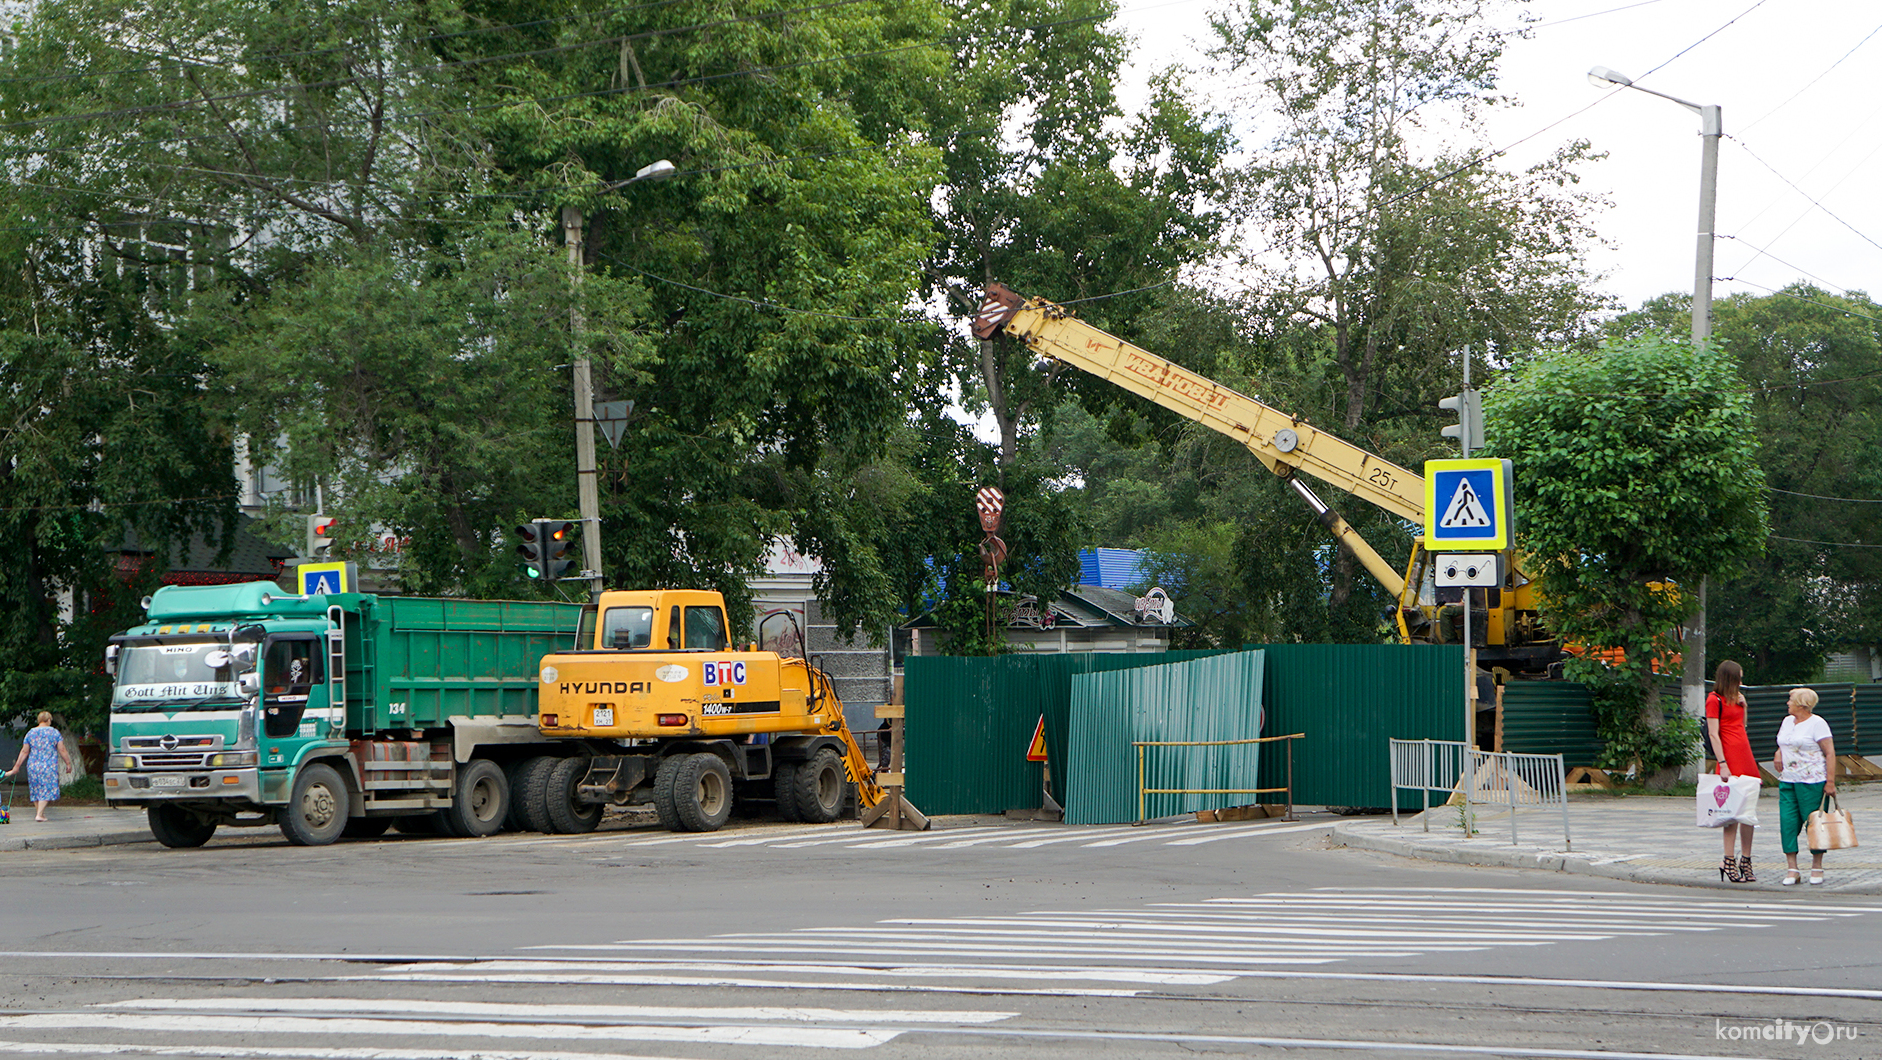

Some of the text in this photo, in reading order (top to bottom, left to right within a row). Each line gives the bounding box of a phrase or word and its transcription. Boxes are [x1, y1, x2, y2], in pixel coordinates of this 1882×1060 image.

[125, 684, 228, 698] Gott Mit Uns
[560, 682, 651, 694] HYUNDAI
[388, 703, 406, 715] 134
